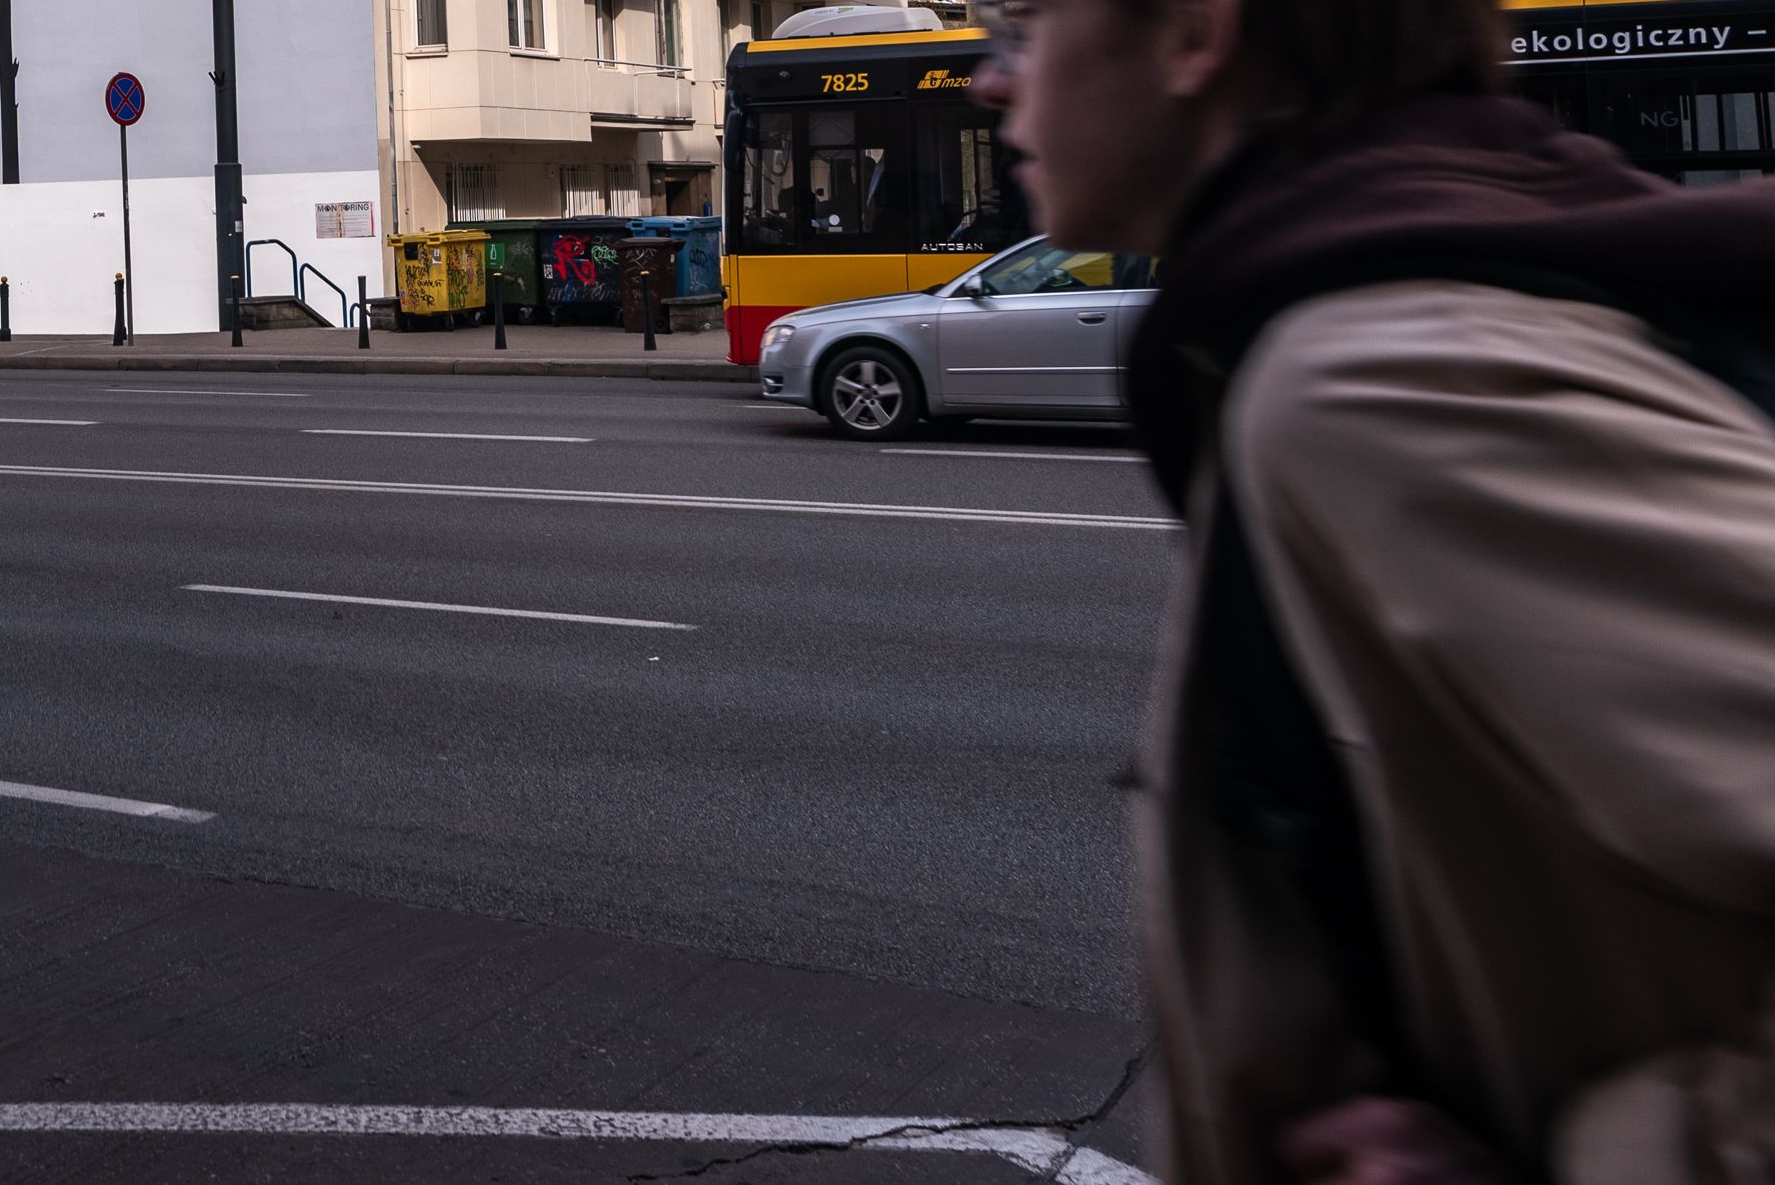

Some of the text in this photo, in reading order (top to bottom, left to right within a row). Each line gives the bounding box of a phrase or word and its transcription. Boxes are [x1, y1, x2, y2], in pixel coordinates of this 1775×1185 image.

[1511, 25, 1731, 54] ekologiczny
[821, 73, 869, 92] 7825
[317, 203, 370, 212] MONTORING
[921, 243, 983, 251] AUTOSAN
